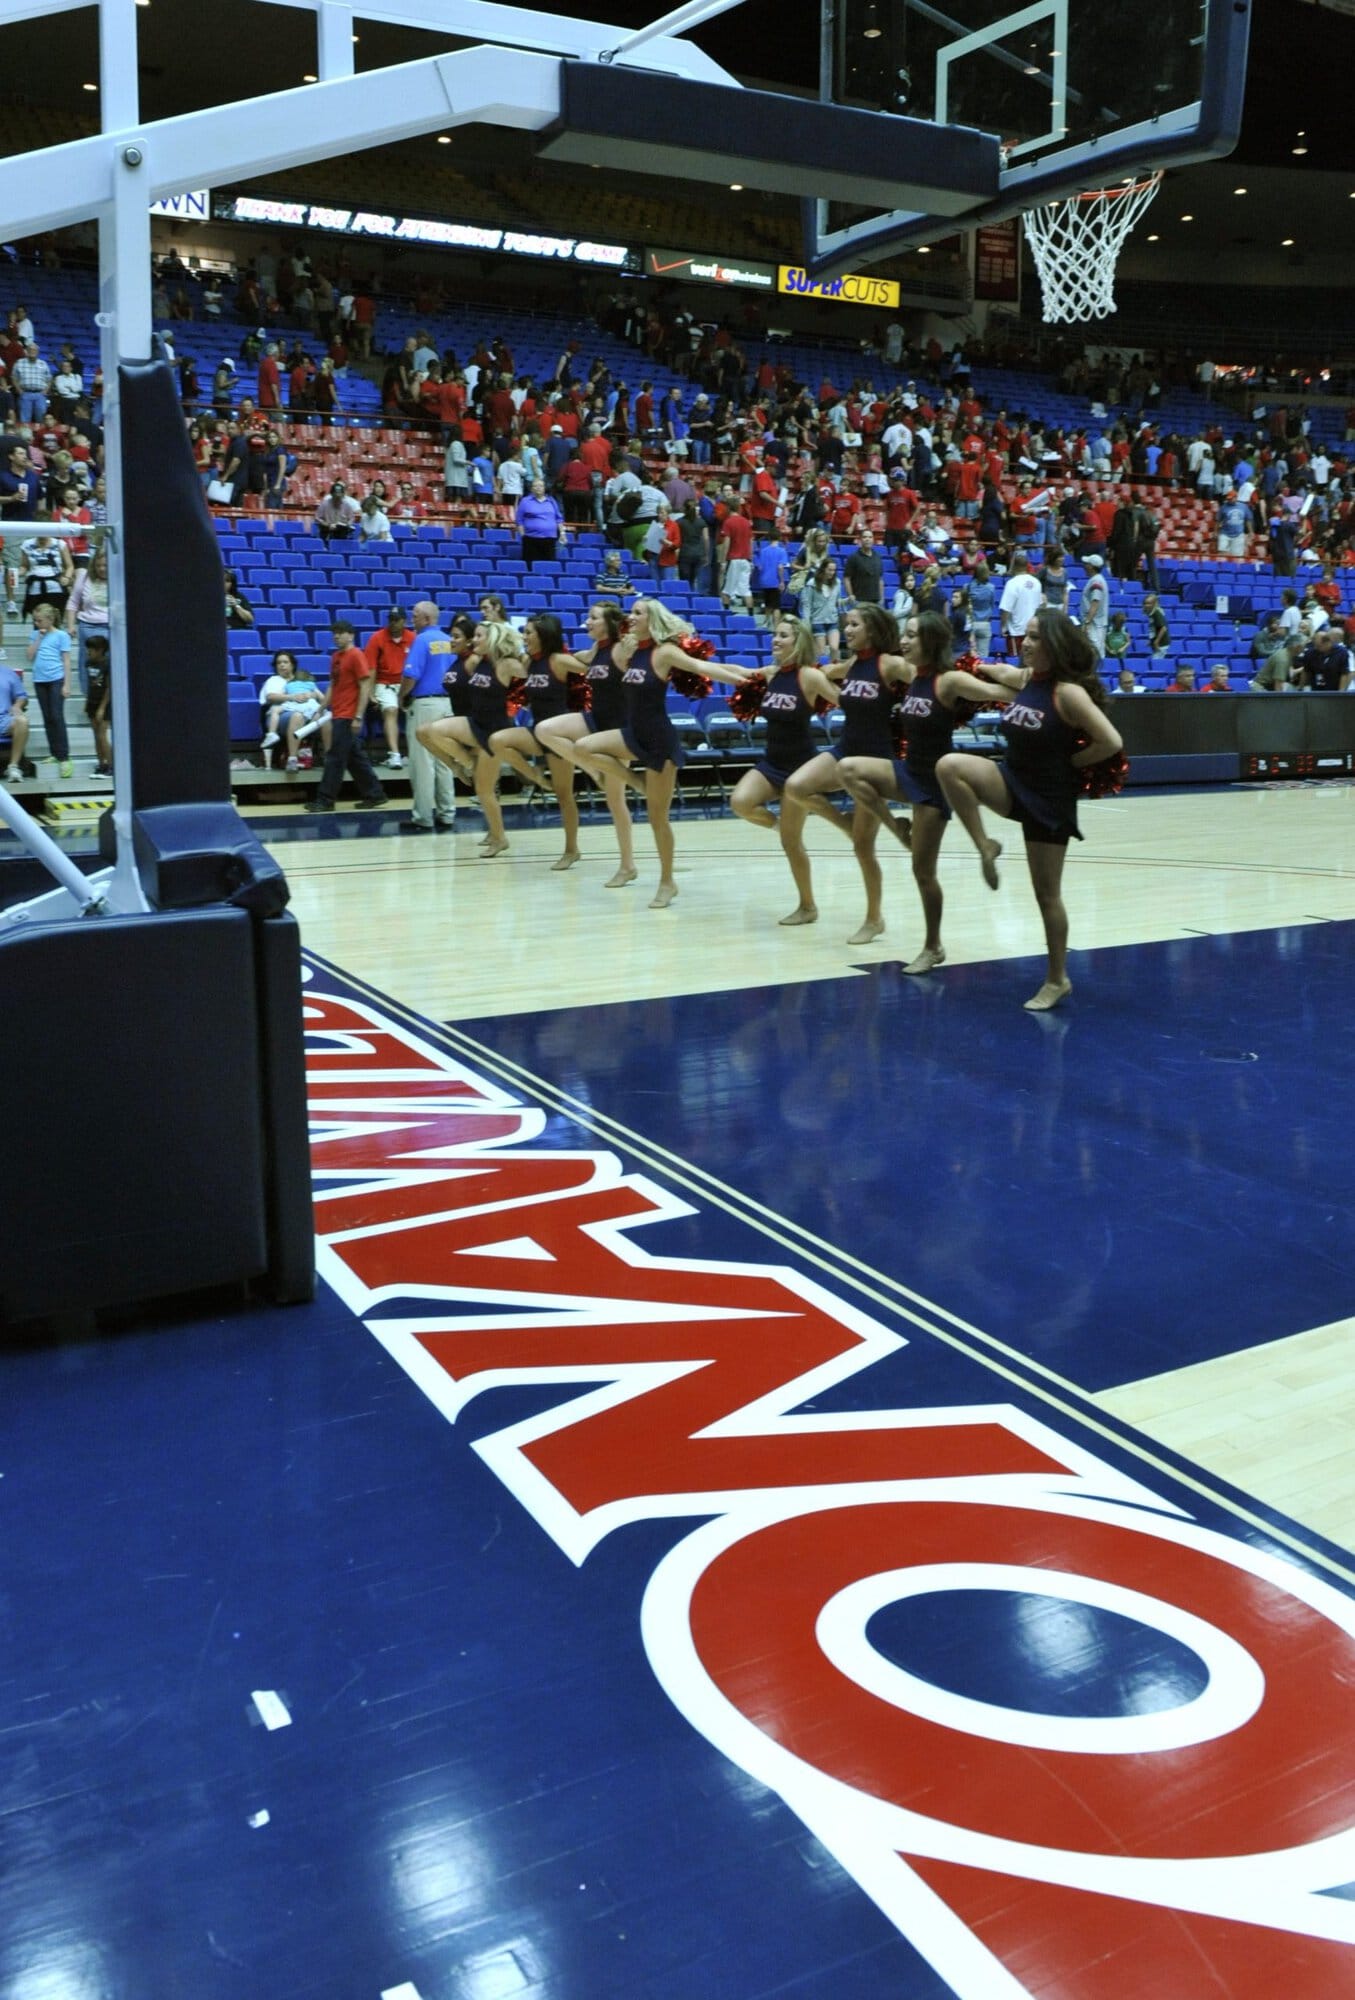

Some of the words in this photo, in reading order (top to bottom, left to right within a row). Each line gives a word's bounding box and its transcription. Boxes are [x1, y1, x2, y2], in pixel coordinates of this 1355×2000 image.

[235, 197, 307, 224] THANK
[308, 206, 351, 229] YOU
[351, 213, 395, 235] FOR
